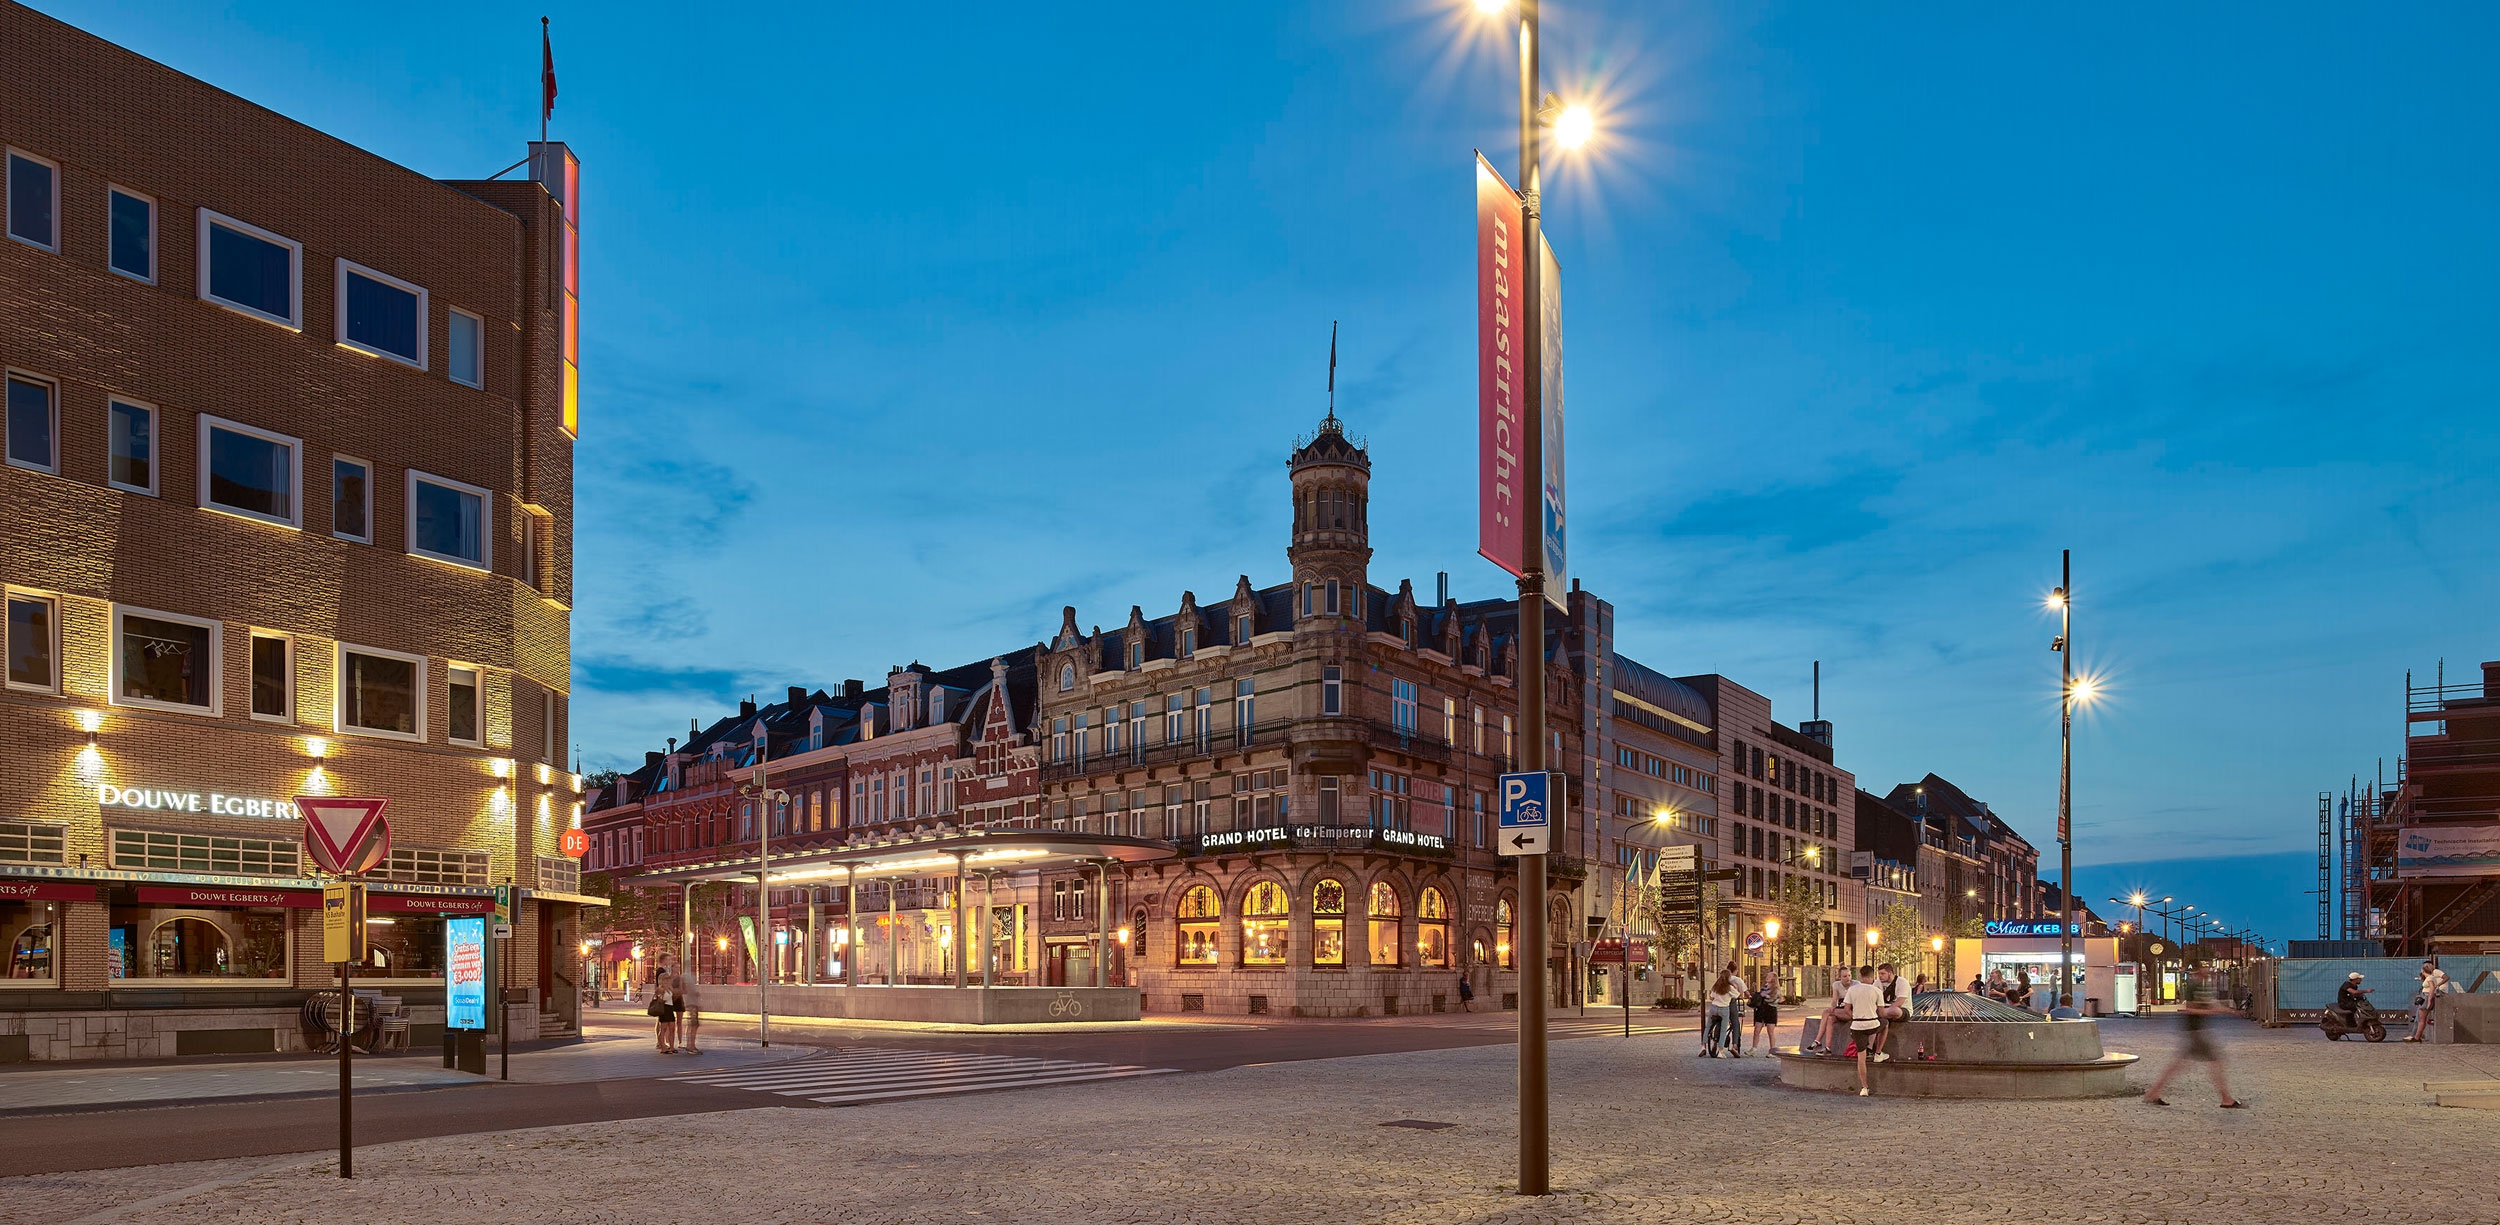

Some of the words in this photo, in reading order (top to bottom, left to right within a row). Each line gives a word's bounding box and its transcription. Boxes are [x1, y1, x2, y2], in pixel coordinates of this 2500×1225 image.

[1412, 778, 1444, 801] HOTEL
[1506, 780, 1527, 812] P
[99, 784, 201, 811] DOUWE
[211, 793, 301, 819] EGBERT
[1202, 831, 1242, 847] GRAND
[1247, 827, 1287, 843] HOTEL
[1296, 825, 1310, 838] de
[1383, 829, 1415, 845] GRAND
[1417, 832, 1445, 849] HOTEL
[191, 892, 227, 901] DOUWE
[229, 893, 269, 903] EGBERTS
[498, 886, 506, 904] P
[1477, 891, 1484, 901] DE
[407, 900, 436, 909] DOUWE
[438, 901, 470, 909] EGBERTS
[2033, 924, 2079, 934] KEBB
